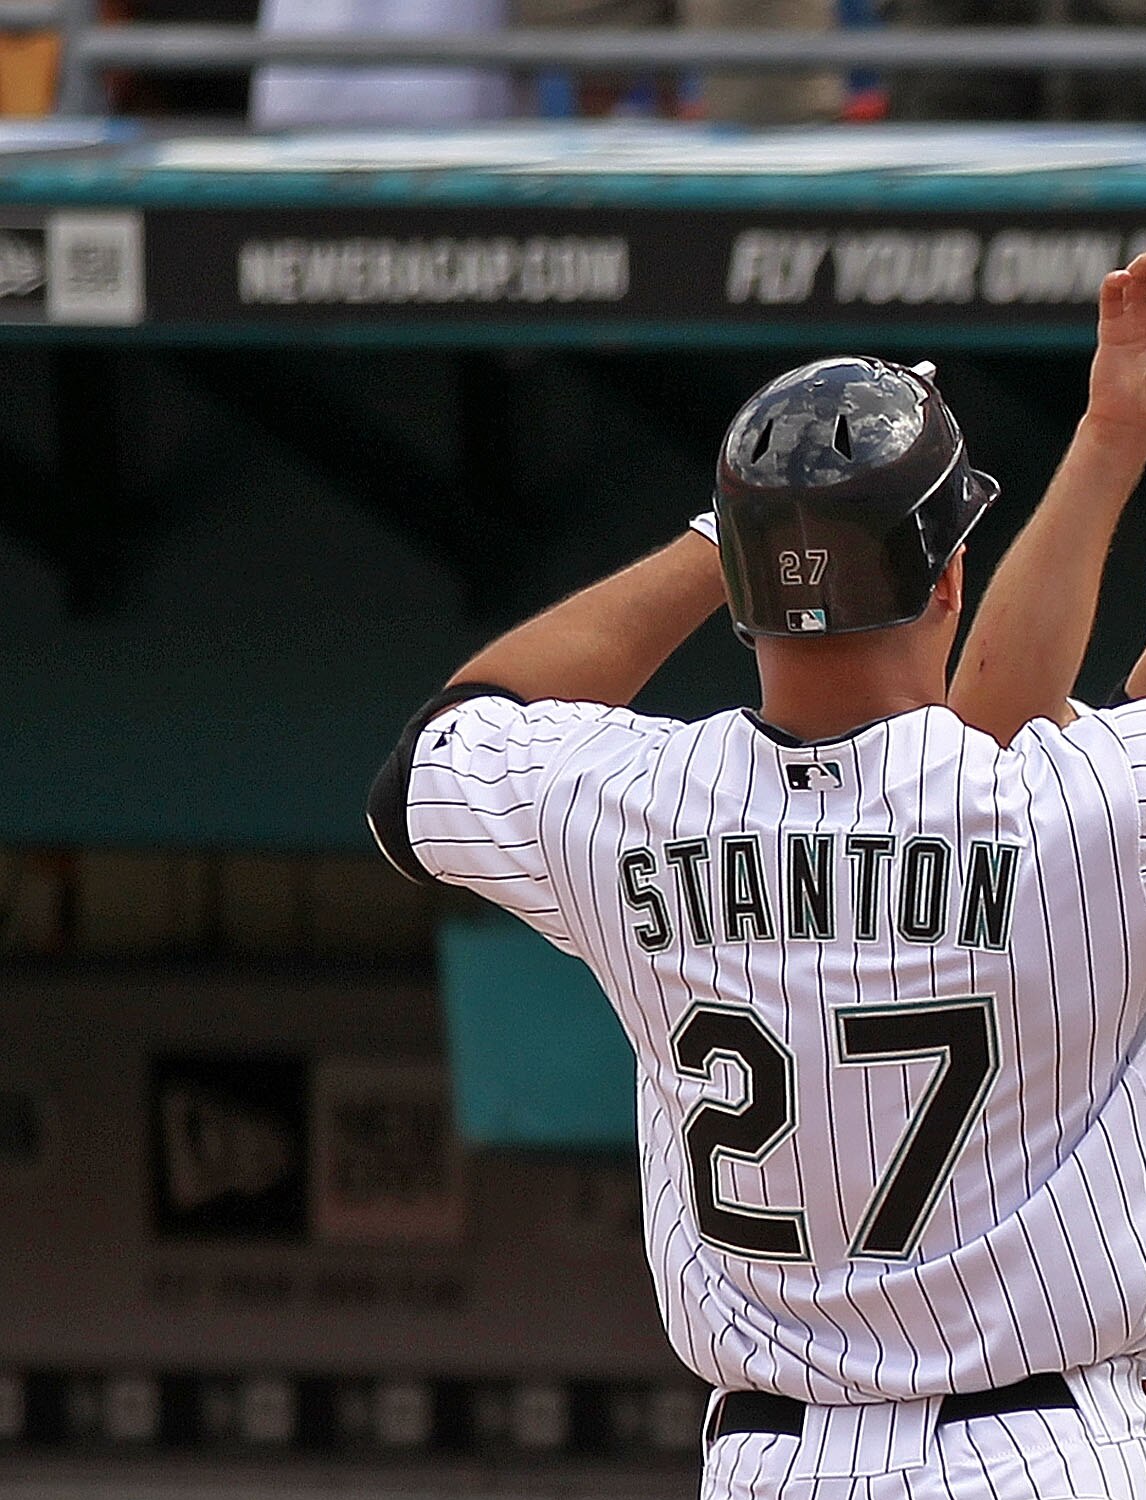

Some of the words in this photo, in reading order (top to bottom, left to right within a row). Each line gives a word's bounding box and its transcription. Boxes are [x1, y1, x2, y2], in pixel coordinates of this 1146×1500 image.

[727, 230, 832, 303] FLY
[835, 230, 980, 303] YOUR
[779, 549, 829, 585] 27
[618, 832, 1022, 954] STANTON
[669, 996, 1001, 1265] 27
